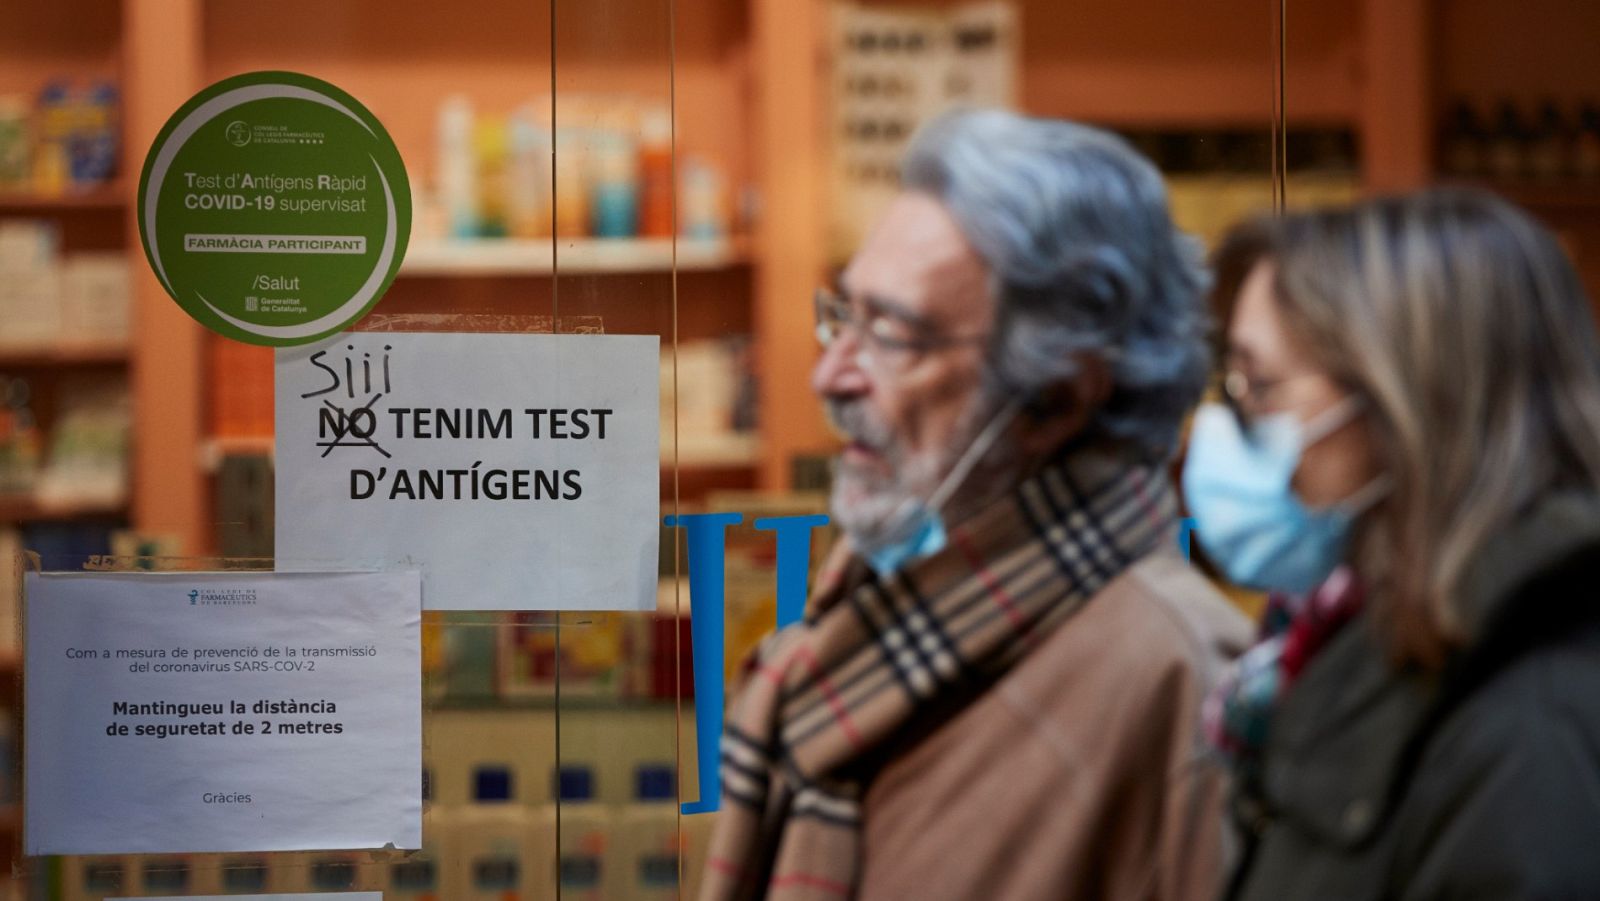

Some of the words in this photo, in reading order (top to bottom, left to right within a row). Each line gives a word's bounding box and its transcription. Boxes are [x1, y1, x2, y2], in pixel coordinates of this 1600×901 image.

[184, 173, 220, 189] Test
[224, 174, 313, 193] d'Antígens
[317, 175, 366, 194] Ràpid
[184, 194, 275, 211] COVID-19
[279, 197, 366, 214] supervisat
[188, 237, 263, 249] FARMÀCIA
[268, 239, 362, 250] PARTICIPANT
[252, 275, 300, 290] /Salut
[318, 408, 377, 440] NO
[388, 408, 512, 439] TENIM
[525, 408, 613, 440] TEST
[66, 648, 97, 659] Com
[102, 650, 110, 658] a
[116, 649, 166, 658] mesura
[171, 647, 188, 658] de
[194, 646, 258, 660] prevenció
[264, 646, 280, 658] de
[286, 646, 296, 658] la
[302, 646, 377, 657] transmissió
[129, 662, 149, 673] del
[153, 662, 231, 672] coronavirus
[234, 661, 315, 672] SARS-COV-2
[113, 701, 224, 718] Mantingueu
[230, 700, 246, 714] la
[252, 699, 336, 714] distància
[106, 722, 129, 736] de
[134, 722, 226, 739] seguretat
[232, 721, 254, 735] de
[260, 722, 272, 735] 2
[278, 722, 343, 735] metres
[202, 792, 252, 804] Gràcies
